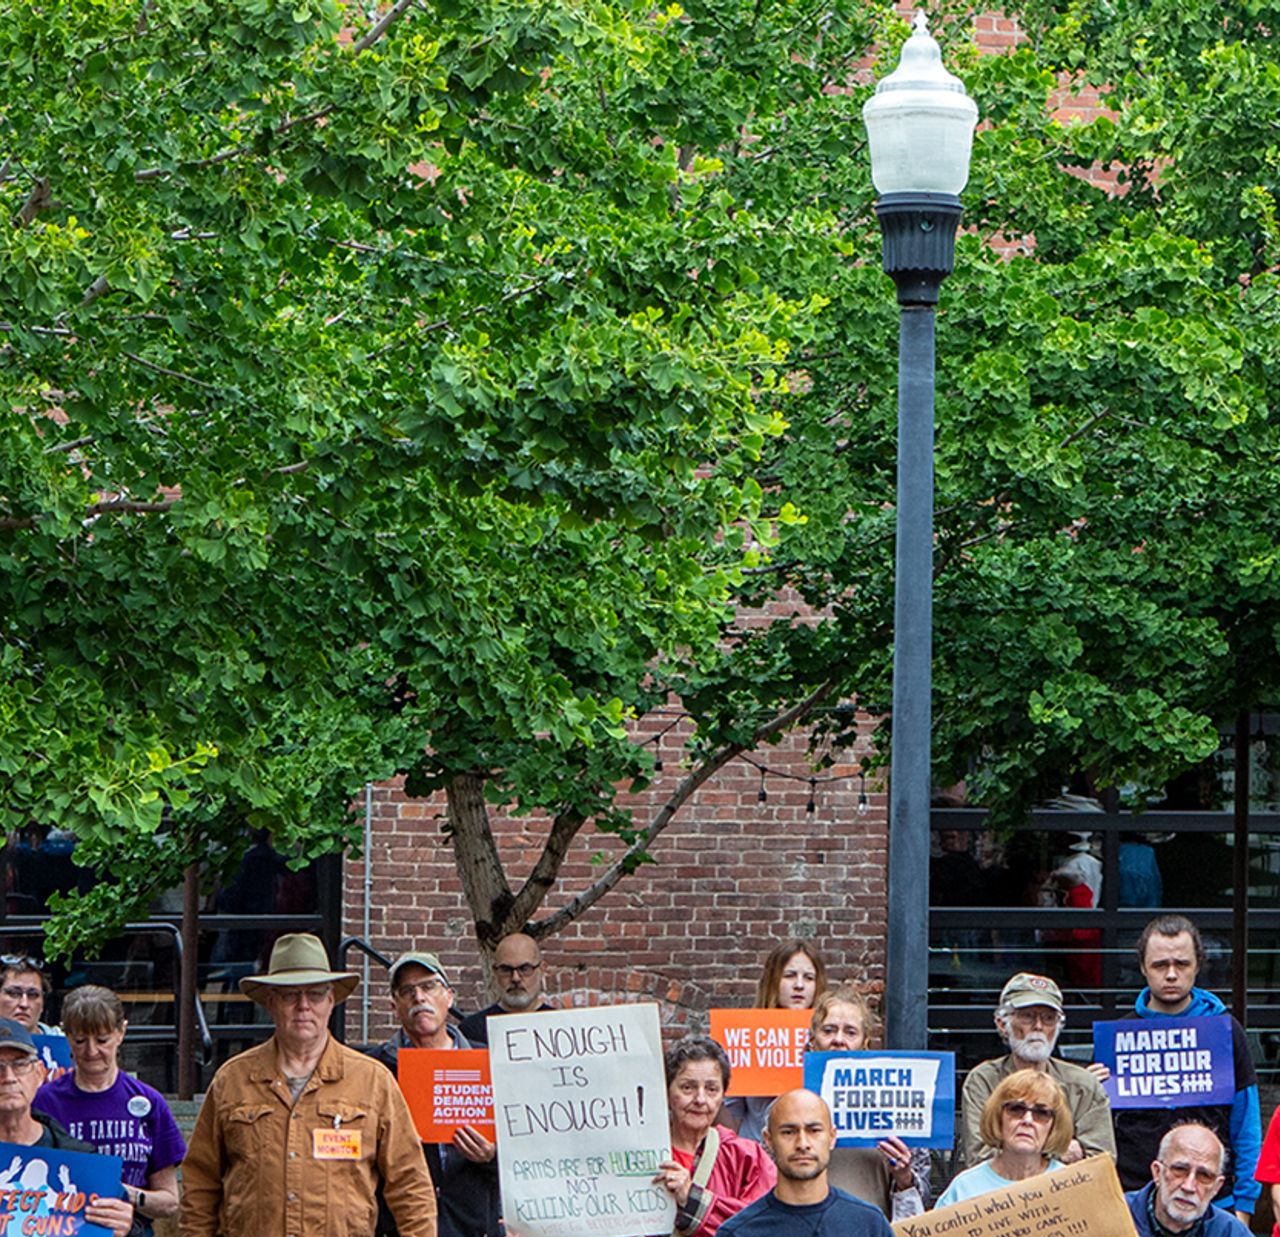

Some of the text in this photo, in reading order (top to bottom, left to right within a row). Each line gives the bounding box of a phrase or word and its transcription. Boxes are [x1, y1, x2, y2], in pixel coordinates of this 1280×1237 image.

[506, 1024, 628, 1061] ENOUGH
[724, 1028, 751, 1047] WE
[755, 1028, 790, 1047] CAN
[1116, 1028, 1197, 1052] MARCH
[730, 1048, 803, 1067] UN VIOLE
[1116, 1050, 1212, 1074] FOR OUR
[552, 1066, 589, 1088] IS
[833, 1068, 912, 1087] MARCH
[1117, 1074, 1180, 1096] LIVES
[433, 1096, 494, 1106] DEMAND
[833, 1090, 925, 1108] FOR OUR
[433, 1107, 486, 1117] ACTION
[833, 1112, 894, 1130] LIVES
[90, 1120, 134, 1139] TAKING
[513, 1158, 556, 1181] ARMS
[558, 1157, 581, 1177] ARE
[585, 1157, 608, 1176] FOR
[566, 1177, 599, 1195] NOT
[515, 1187, 668, 1222] KILLING OUR KIDS
[984, 1193, 1016, 1216] what
[988, 1216, 1012, 1231] LIVE
